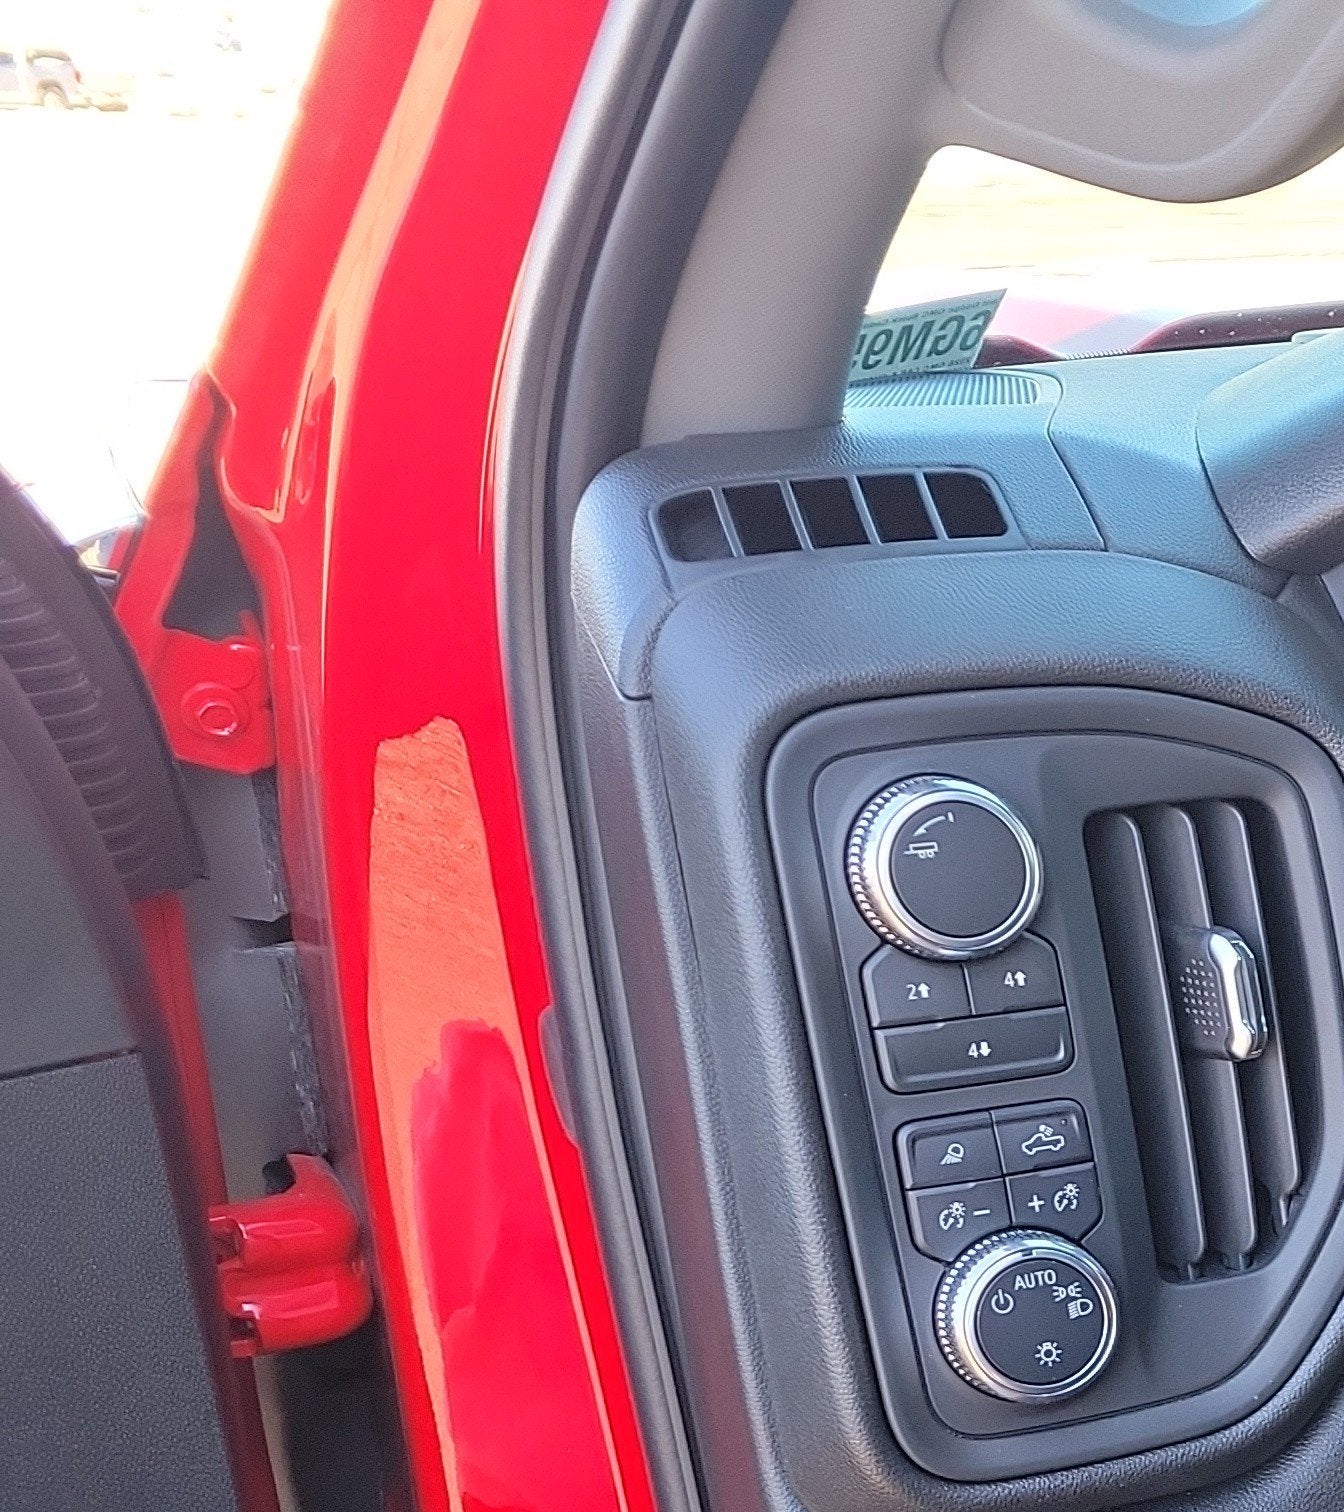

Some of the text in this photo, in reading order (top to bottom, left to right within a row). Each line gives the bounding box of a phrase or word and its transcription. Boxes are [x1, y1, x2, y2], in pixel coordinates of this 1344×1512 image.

[1003, 971, 1015, 988] 4
[906, 984, 918, 1001] 2
[967, 1042, 979, 1059] 4
[1014, 1269, 1057, 1291] AUTO
